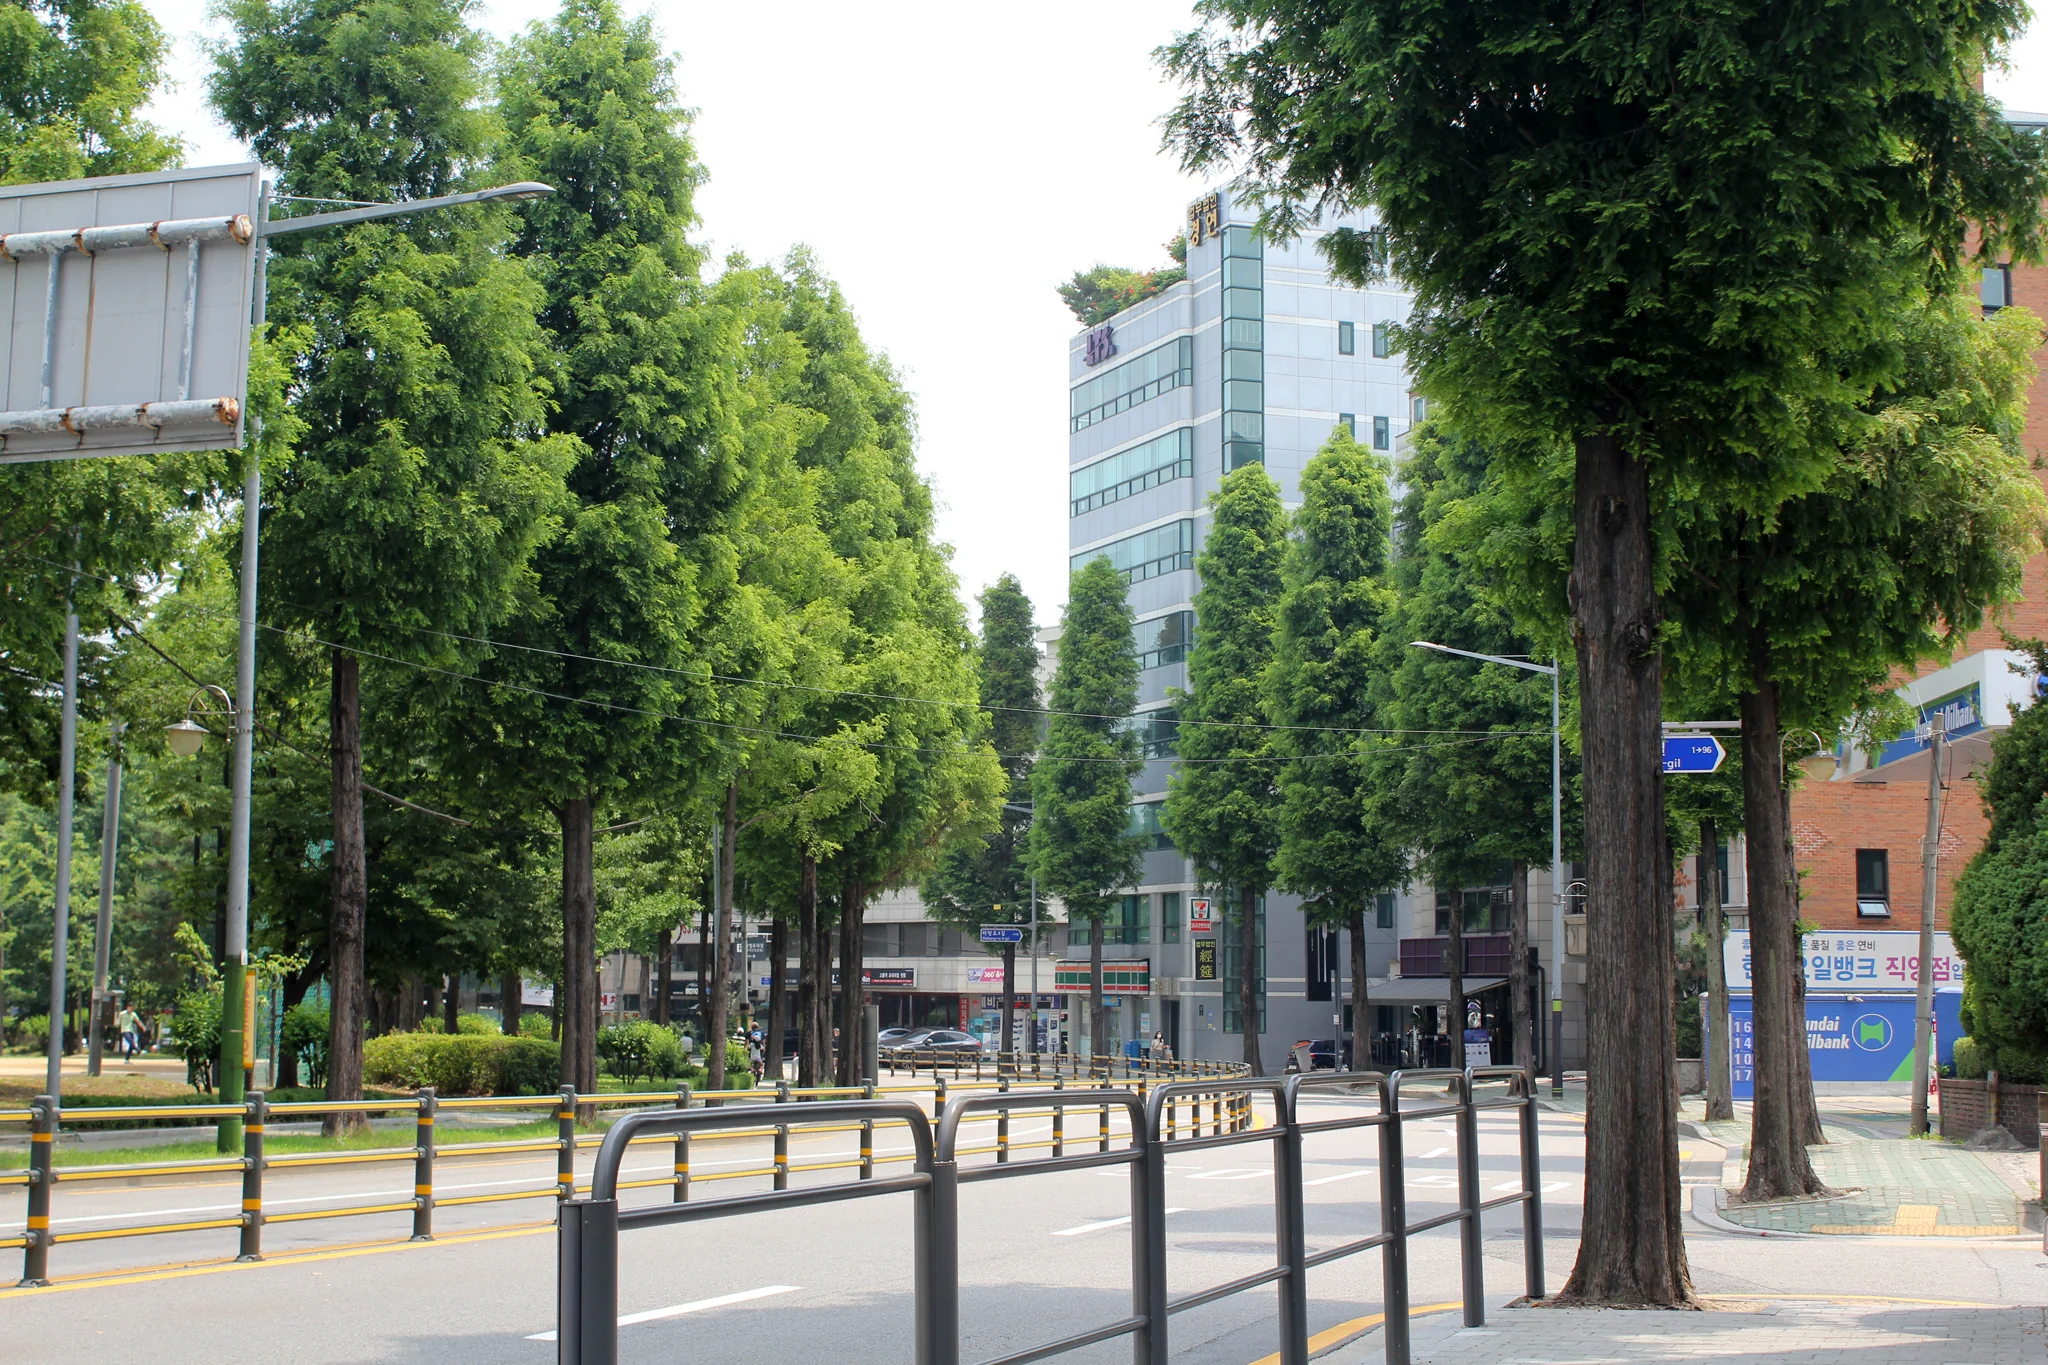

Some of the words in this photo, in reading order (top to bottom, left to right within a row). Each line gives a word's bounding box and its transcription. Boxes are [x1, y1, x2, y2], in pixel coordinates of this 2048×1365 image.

[1662, 758, 1681, 770] -gil
[1811, 939, 1830, 951] 품질
[1836, 940, 1855, 951] 좋은
[1857, 940, 1876, 951] 연비
[1734, 1021, 1752, 1033] 16
[1734, 1037, 1752, 1049] 14
[1807, 1034, 1850, 1049] ilbank
[1734, 1053, 1752, 1065] 10
[1734, 1069, 1752, 1081] 17
